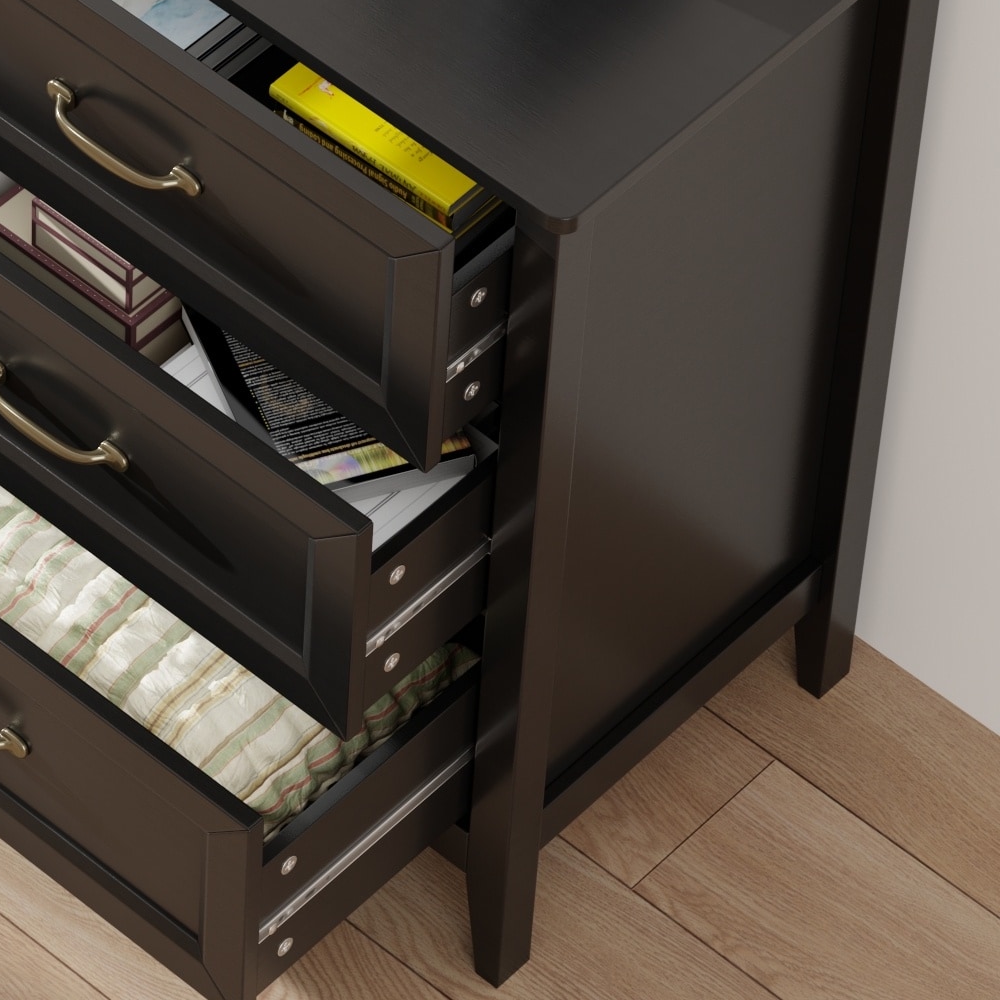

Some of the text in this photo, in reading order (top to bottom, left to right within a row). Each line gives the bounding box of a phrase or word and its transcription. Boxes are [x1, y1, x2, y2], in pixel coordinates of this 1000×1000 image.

[299, 123, 408, 199] Audio Signal Processing and Coding
[381, 164, 417, 191] ANIMAL
